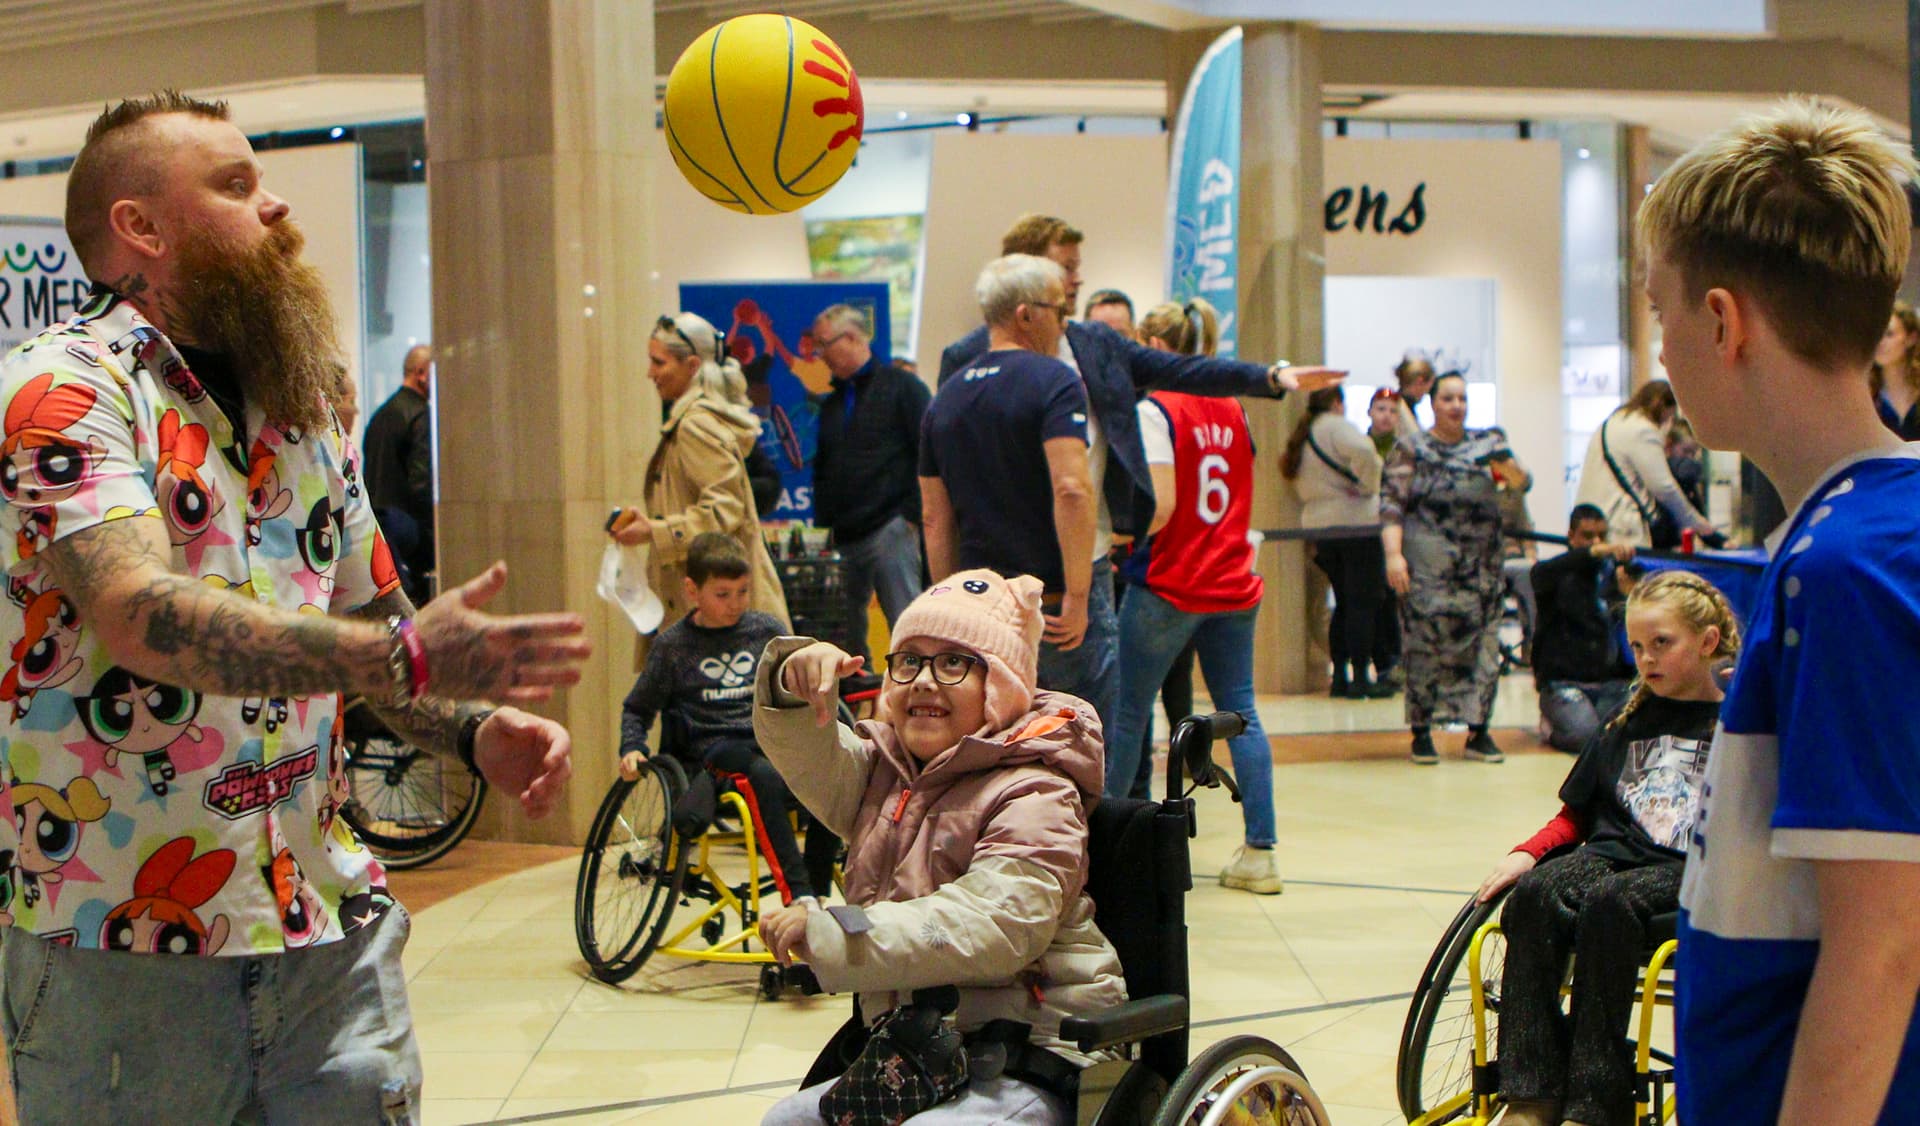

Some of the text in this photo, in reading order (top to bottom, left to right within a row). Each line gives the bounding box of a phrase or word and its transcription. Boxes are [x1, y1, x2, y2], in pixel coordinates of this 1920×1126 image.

[1325, 182, 1426, 234] ens
[775, 486, 814, 511] AS
[1198, 454, 1230, 525] 6
